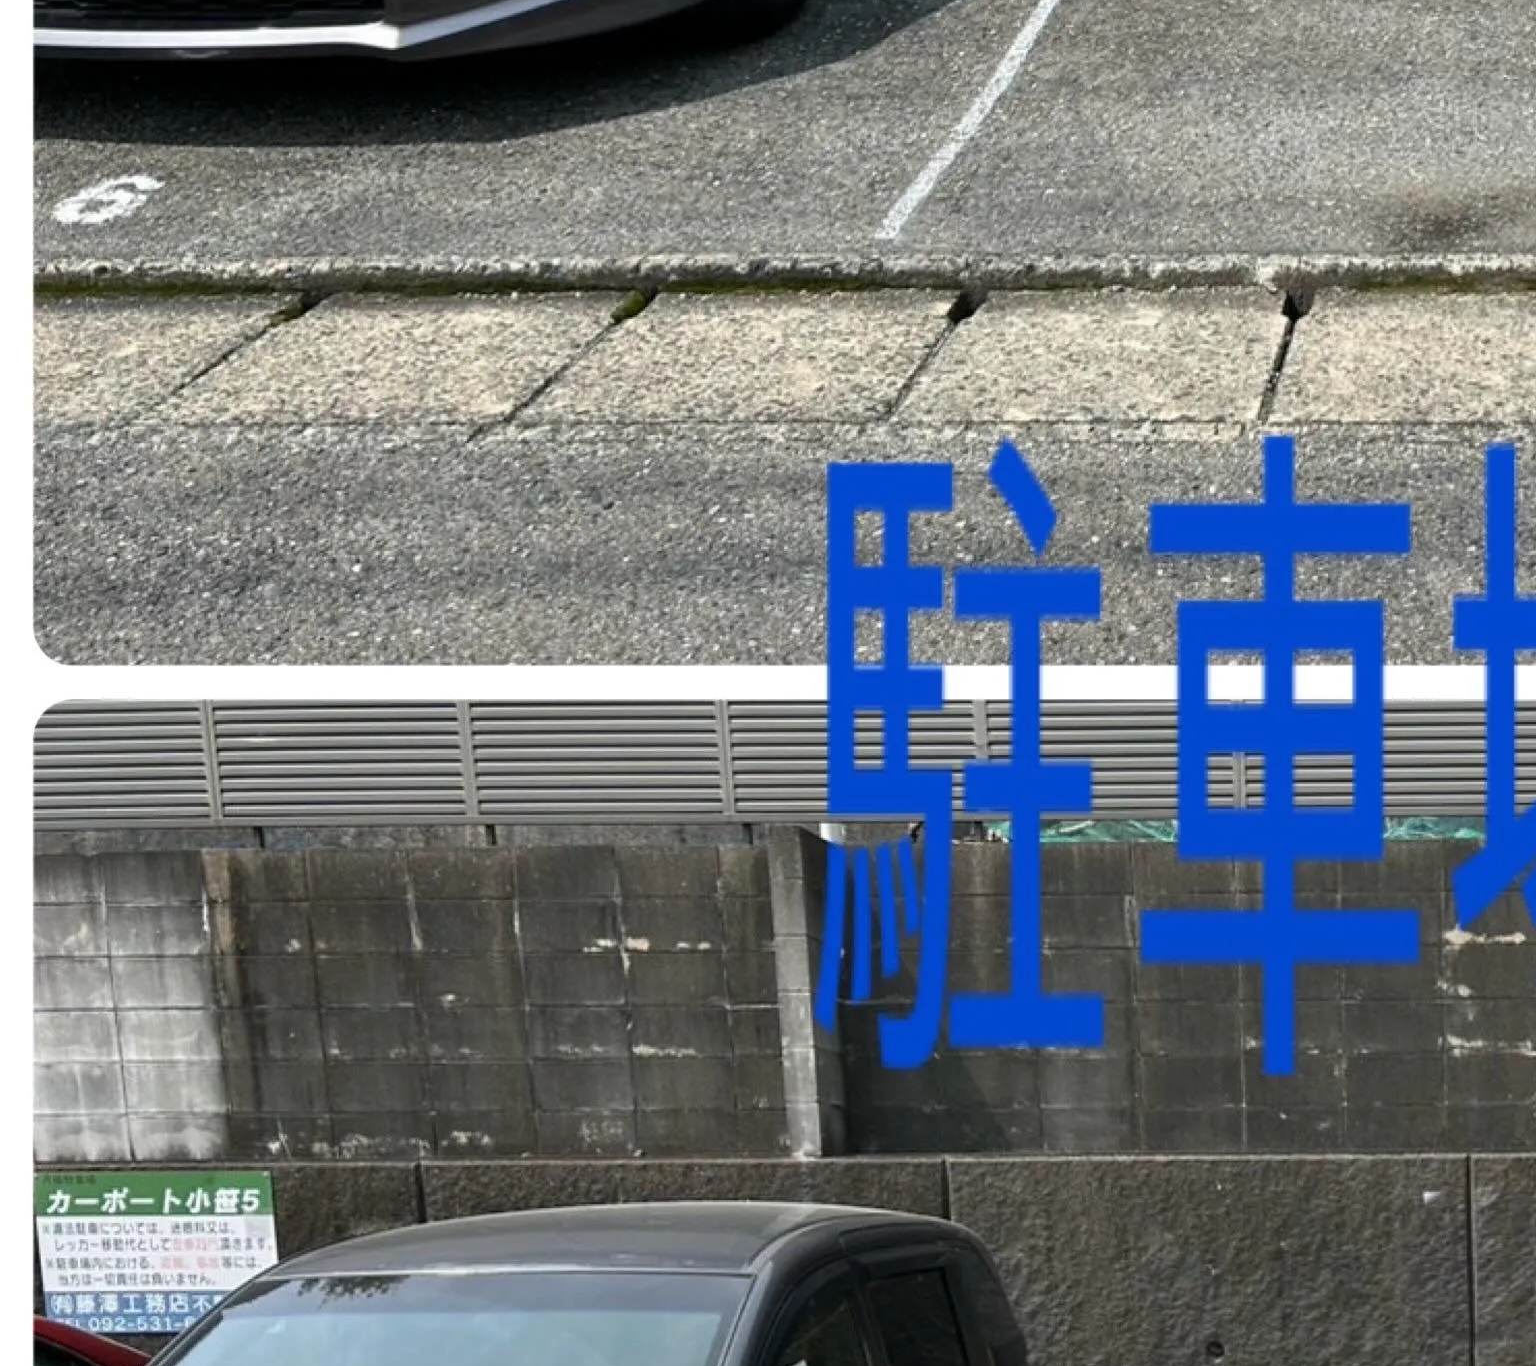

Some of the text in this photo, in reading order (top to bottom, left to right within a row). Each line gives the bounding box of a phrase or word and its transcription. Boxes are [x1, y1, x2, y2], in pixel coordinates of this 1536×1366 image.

[52, 174, 165, 224] 6
[46, 1188, 260, 1214] カーポート小笹5
